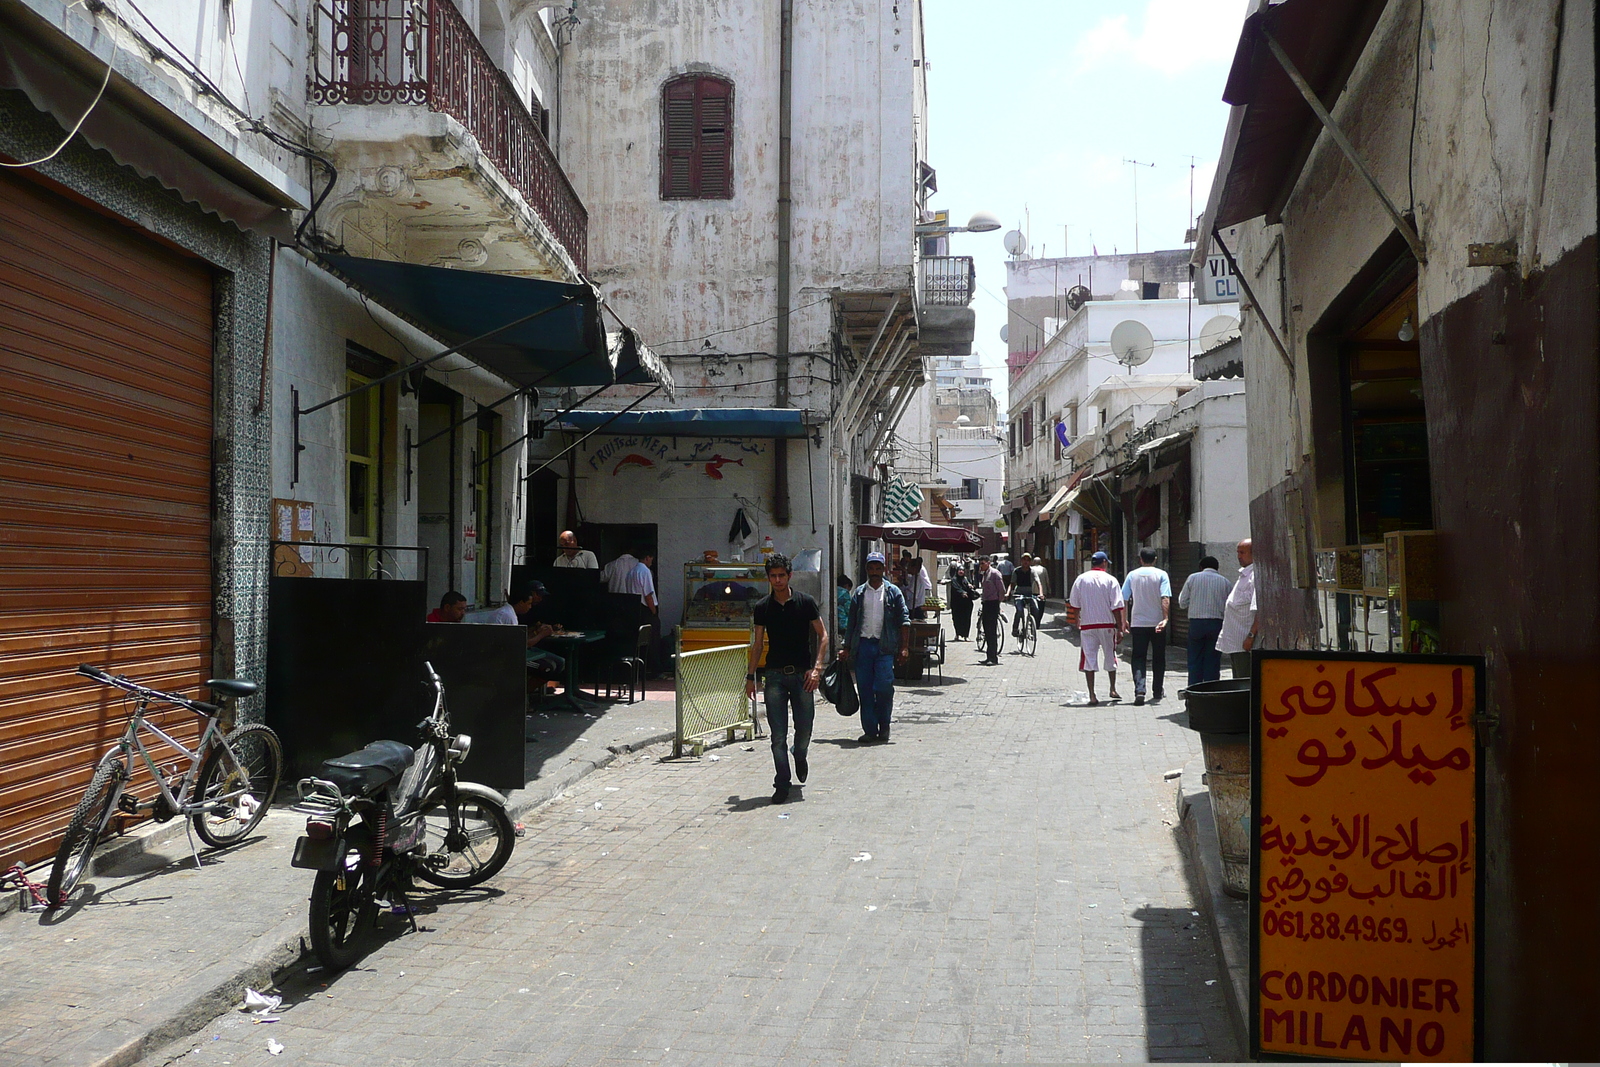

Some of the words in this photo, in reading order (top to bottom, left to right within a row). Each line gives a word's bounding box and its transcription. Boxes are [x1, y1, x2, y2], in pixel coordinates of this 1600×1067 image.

[642, 437, 668, 459] MER
[1263, 664, 1467, 739] إسكافي
[1285, 720, 1471, 787] ميلانو
[1261, 813, 1370, 866] الأحذية
[1370, 817, 1472, 875] إصلاح
[1347, 864, 1457, 905] القالب
[1260, 970, 1460, 1014] CORDONIER
[1263, 1008, 1445, 1057] MILANO
